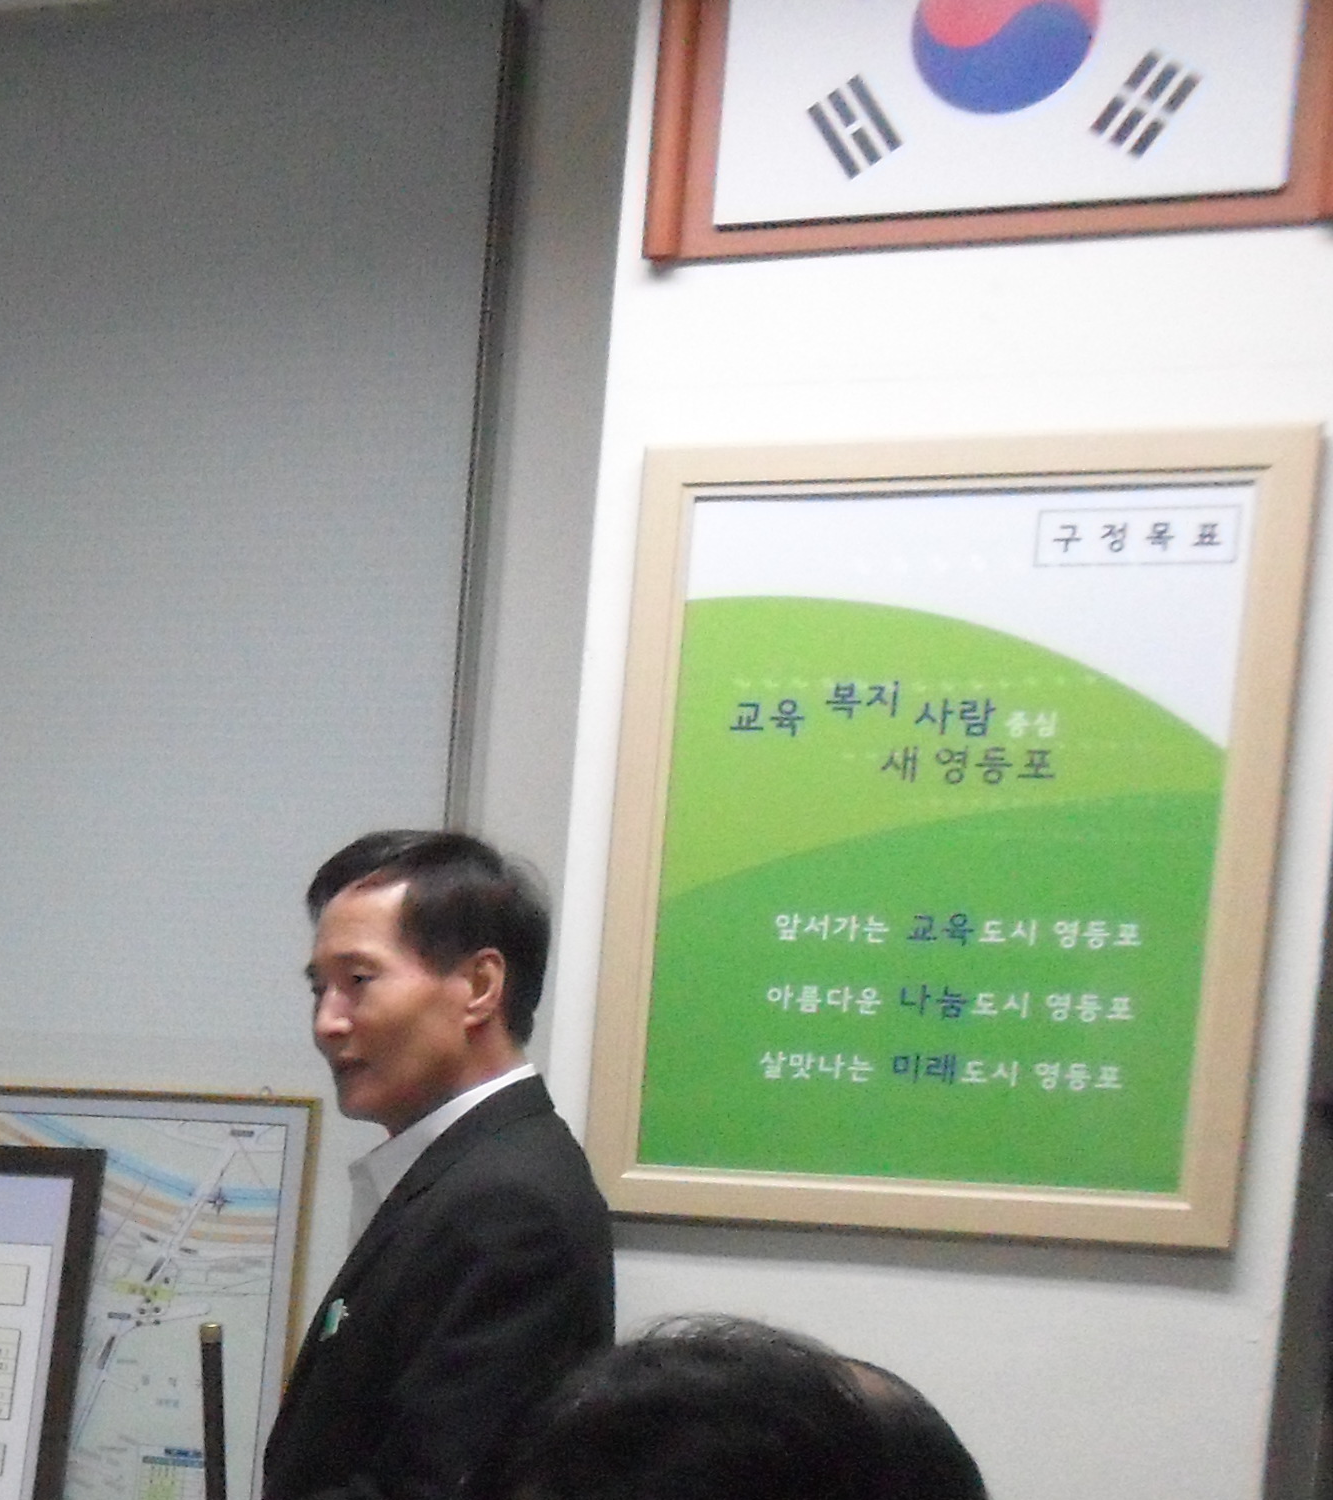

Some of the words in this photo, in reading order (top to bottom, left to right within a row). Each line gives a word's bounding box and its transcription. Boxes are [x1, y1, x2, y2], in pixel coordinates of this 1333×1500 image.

[1052, 521, 1222, 553] 구정목표
[729, 699, 805, 737] 교육
[825, 680, 901, 718] 복지
[880, 746, 918, 783] 새
[935, 745, 1057, 785] 영등포
[774, 913, 889, 944] 앞서가는
[1052, 919, 1141, 950] 영등포
[766, 984, 881, 1014] 아름다운
[1045, 991, 1133, 1022] 영등포
[760, 1051, 874, 1083] 살맛나는
[1035, 1060, 1123, 1092] 영등포
